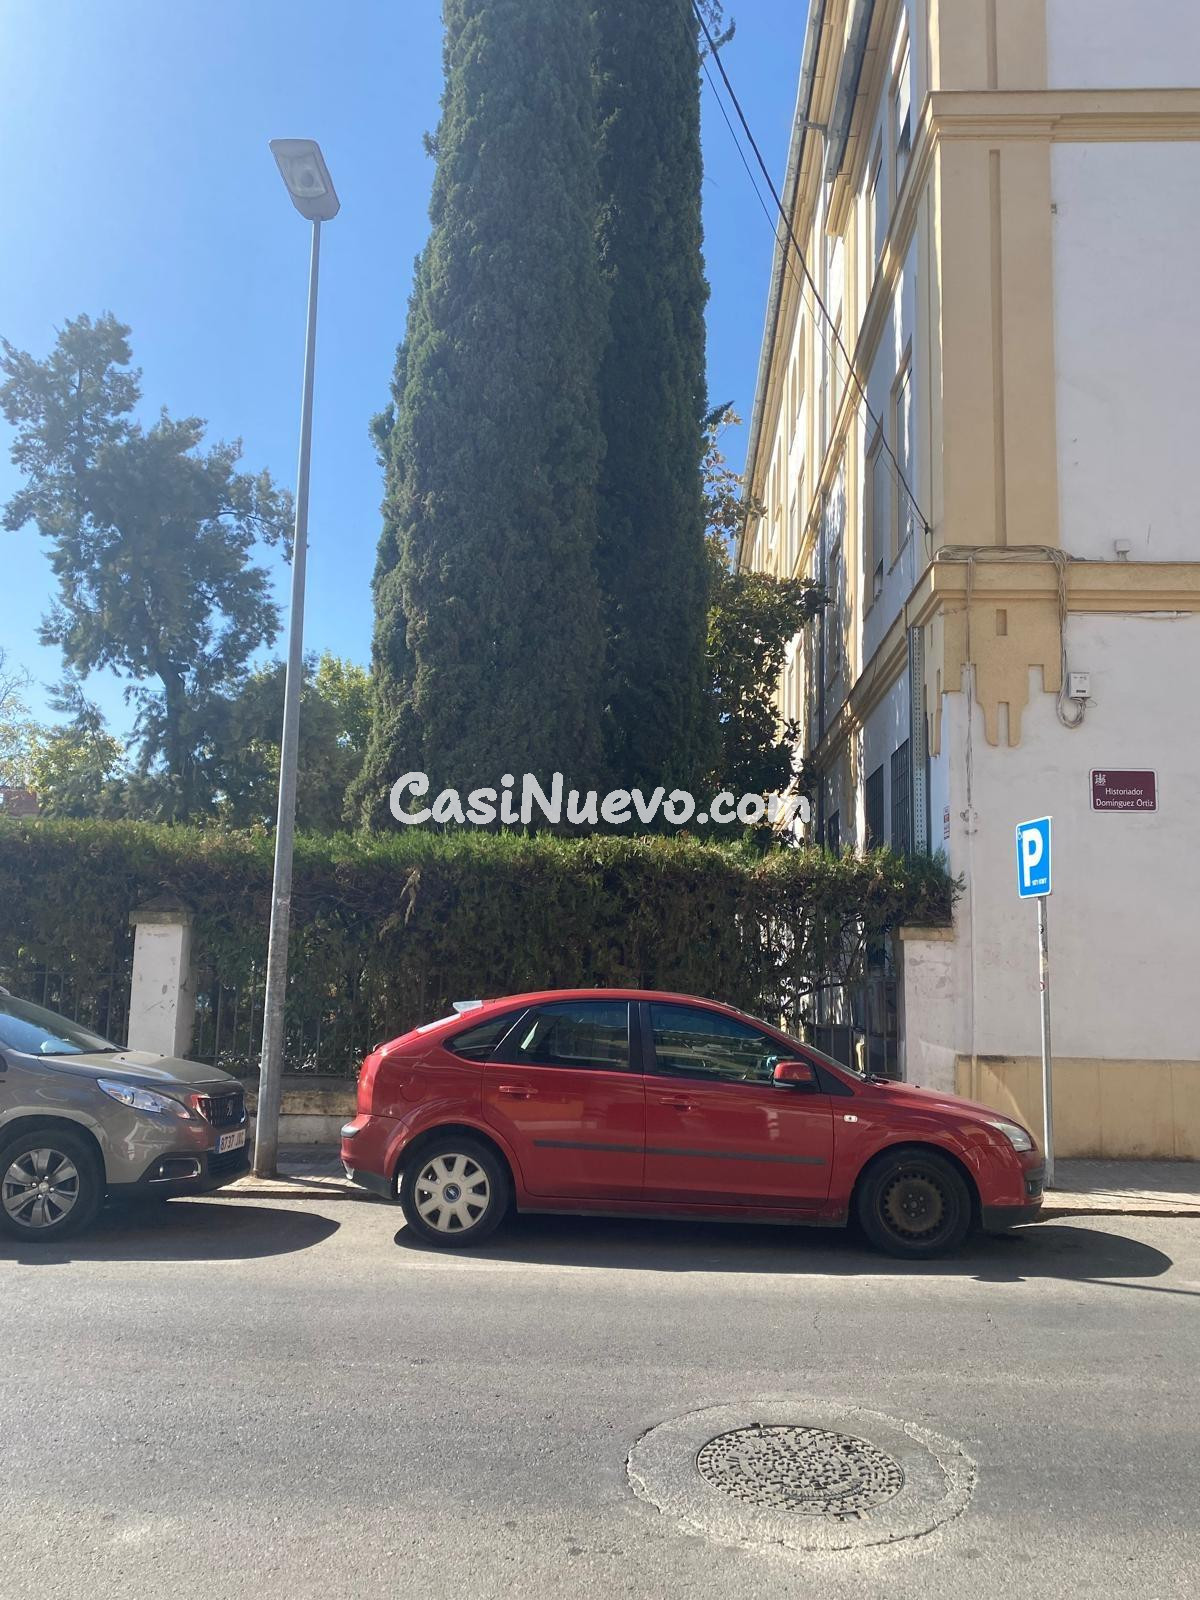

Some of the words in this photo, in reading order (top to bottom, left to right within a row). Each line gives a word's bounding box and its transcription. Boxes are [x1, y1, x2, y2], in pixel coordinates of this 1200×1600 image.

[1105, 787, 1144, 796] Historiador
[1136, 798, 1154, 807] Ortiz
[1022, 828, 1043, 887] P
